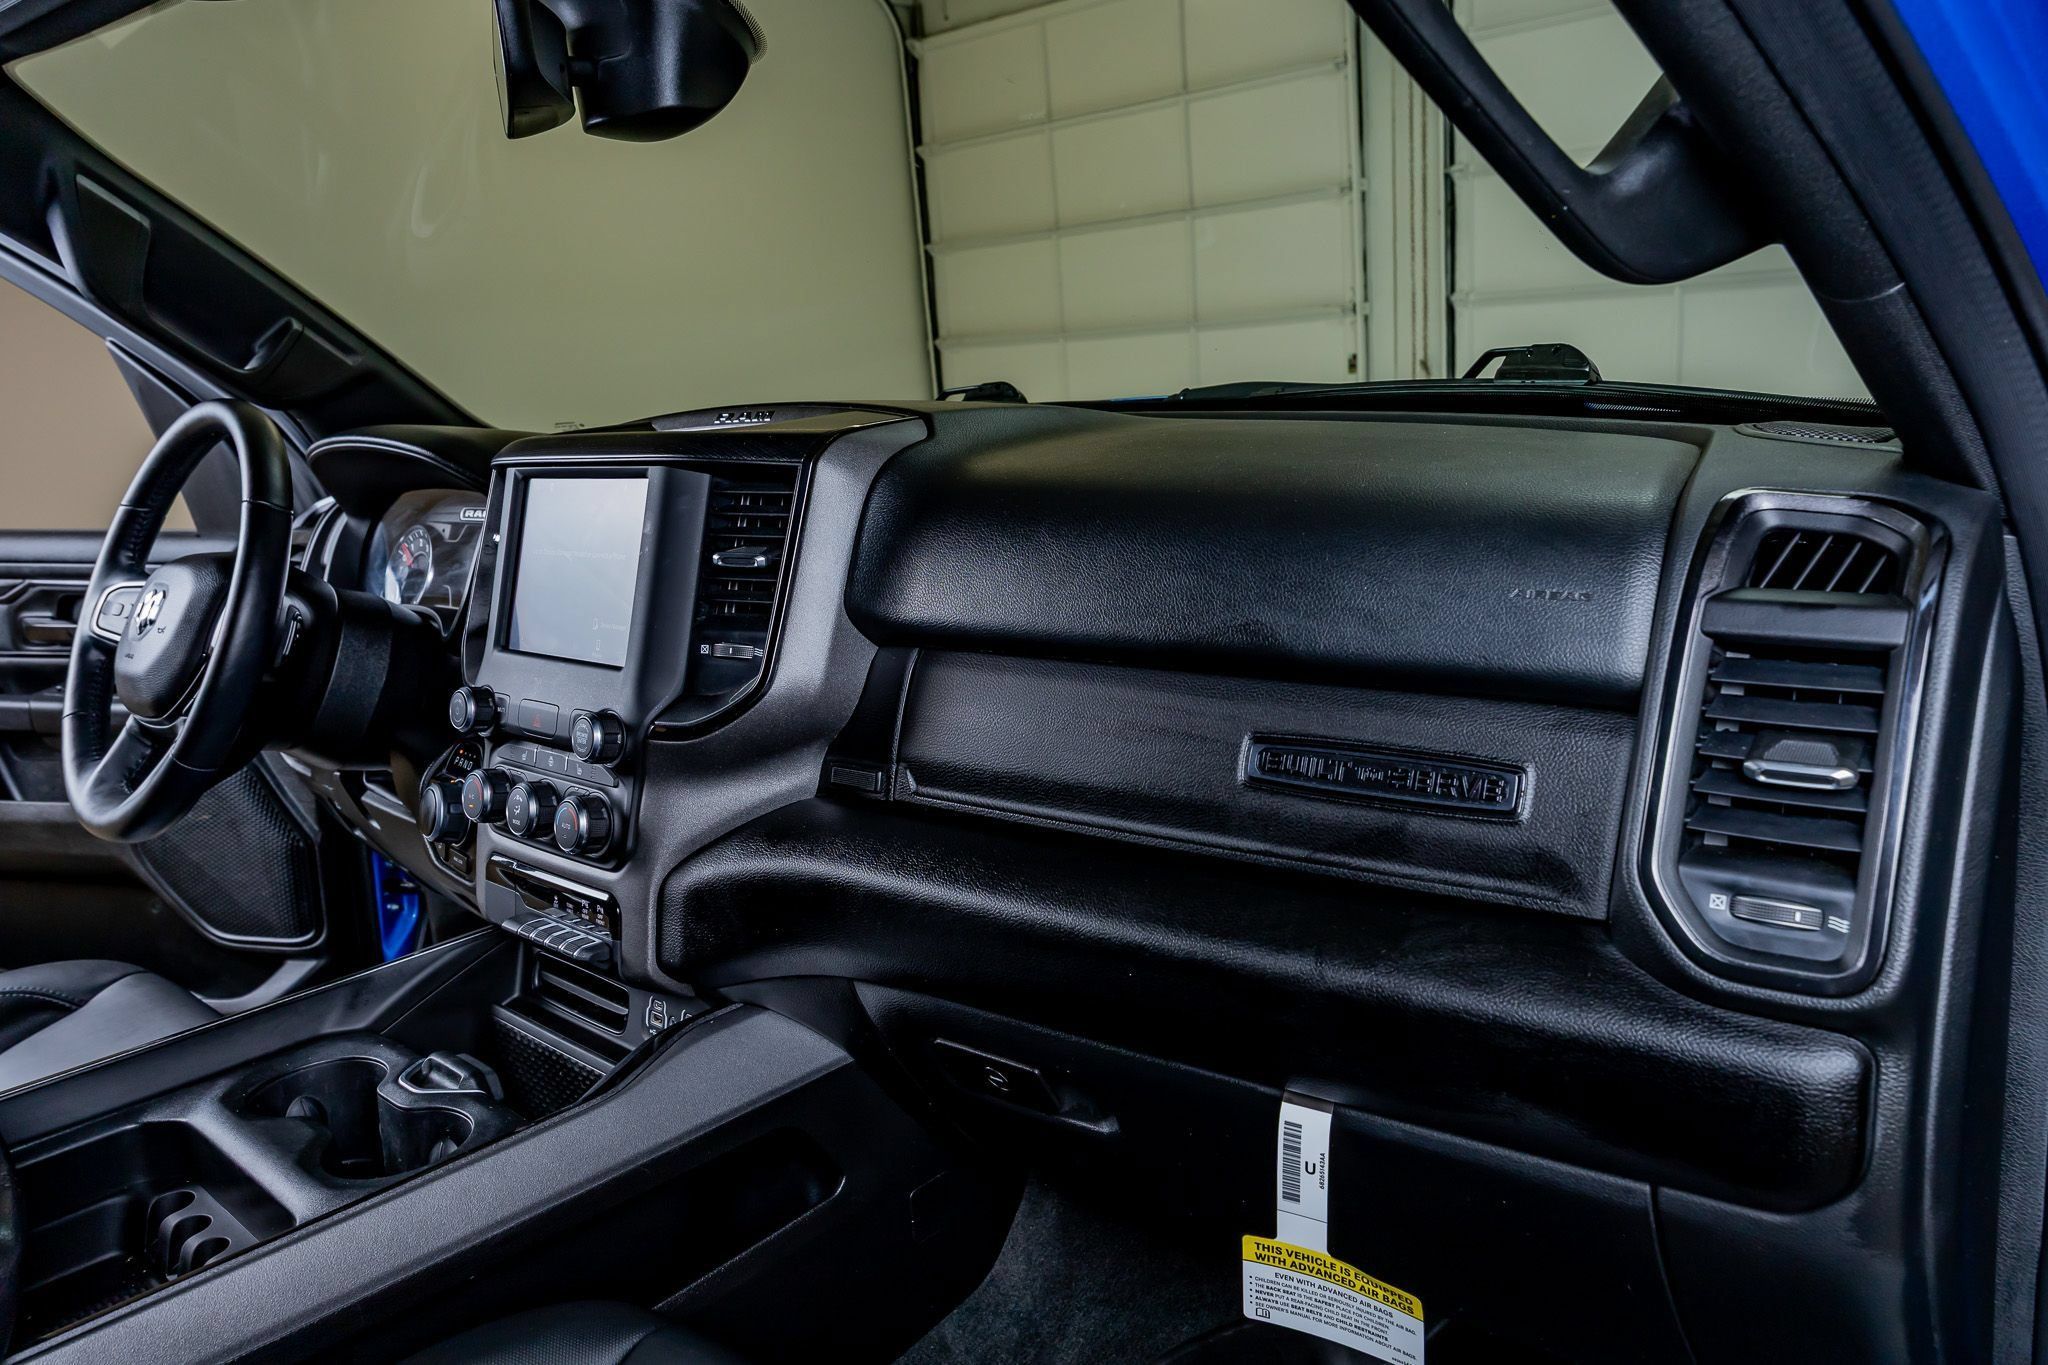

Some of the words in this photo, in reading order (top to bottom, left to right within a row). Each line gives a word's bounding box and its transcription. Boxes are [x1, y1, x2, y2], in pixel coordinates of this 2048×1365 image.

[1387, 768, 1505, 803] SERVE
[1254, 1242, 1283, 1255] THIS
[1285, 1249, 1337, 1271] VEHICLE
[1340, 1265, 1351, 1277] IS
[1354, 1272, 1413, 1305] EQUIPPED
[1254, 1252, 1286, 1266] WITH
[1290, 1261, 1356, 1288] ADVANCED
[1359, 1285, 1379, 1298] AIR
[1383, 1295, 1414, 1314] BAGS
[1254, 1276, 1280, 1286] CHILDREN
[1301, 1287, 1318, 1296] KILLED
[1328, 1296, 1355, 1308] SERIOUSLY
[1356, 1306, 1376, 1318] INJURED
[1385, 1318, 1394, 1326] THE
[1255, 1289, 1274, 1297] NEVER
[1324, 1308, 1340, 1316] CHILD
[1341, 1313, 1353, 1321] SEAT
[1361, 1320, 1370, 1328] THE
[1255, 1295, 1278, 1305] ALWAYS
[1291, 1304, 1305, 1312] SEAT
[1306, 1308, 1323, 1316] BELTS
[1335, 1318, 1353, 1327] CHILD
[1266, 1285, 1281, 1293] BACK
[1314, 1298, 1335, 1307] SAFEST
[1336, 1305, 1351, 1315] PLACE
[1353, 1311, 1363, 1319] FOR
[1274, 1272, 1295, 1282] EVEN
[1296, 1278, 1316, 1288] WITH
[1317, 1284, 1357, 1303] ADVANCED
[1359, 1300, 1372, 1309] AIR
[1373, 1306, 1393, 1318] BAGS
[1290, 1310, 1311, 1321] MANUAL
[1324, 1320, 1338, 1329] MORE
[1339, 1325, 1374, 1342] INFORMATION
[1375, 1340, 1392, 1350] ABOUT
